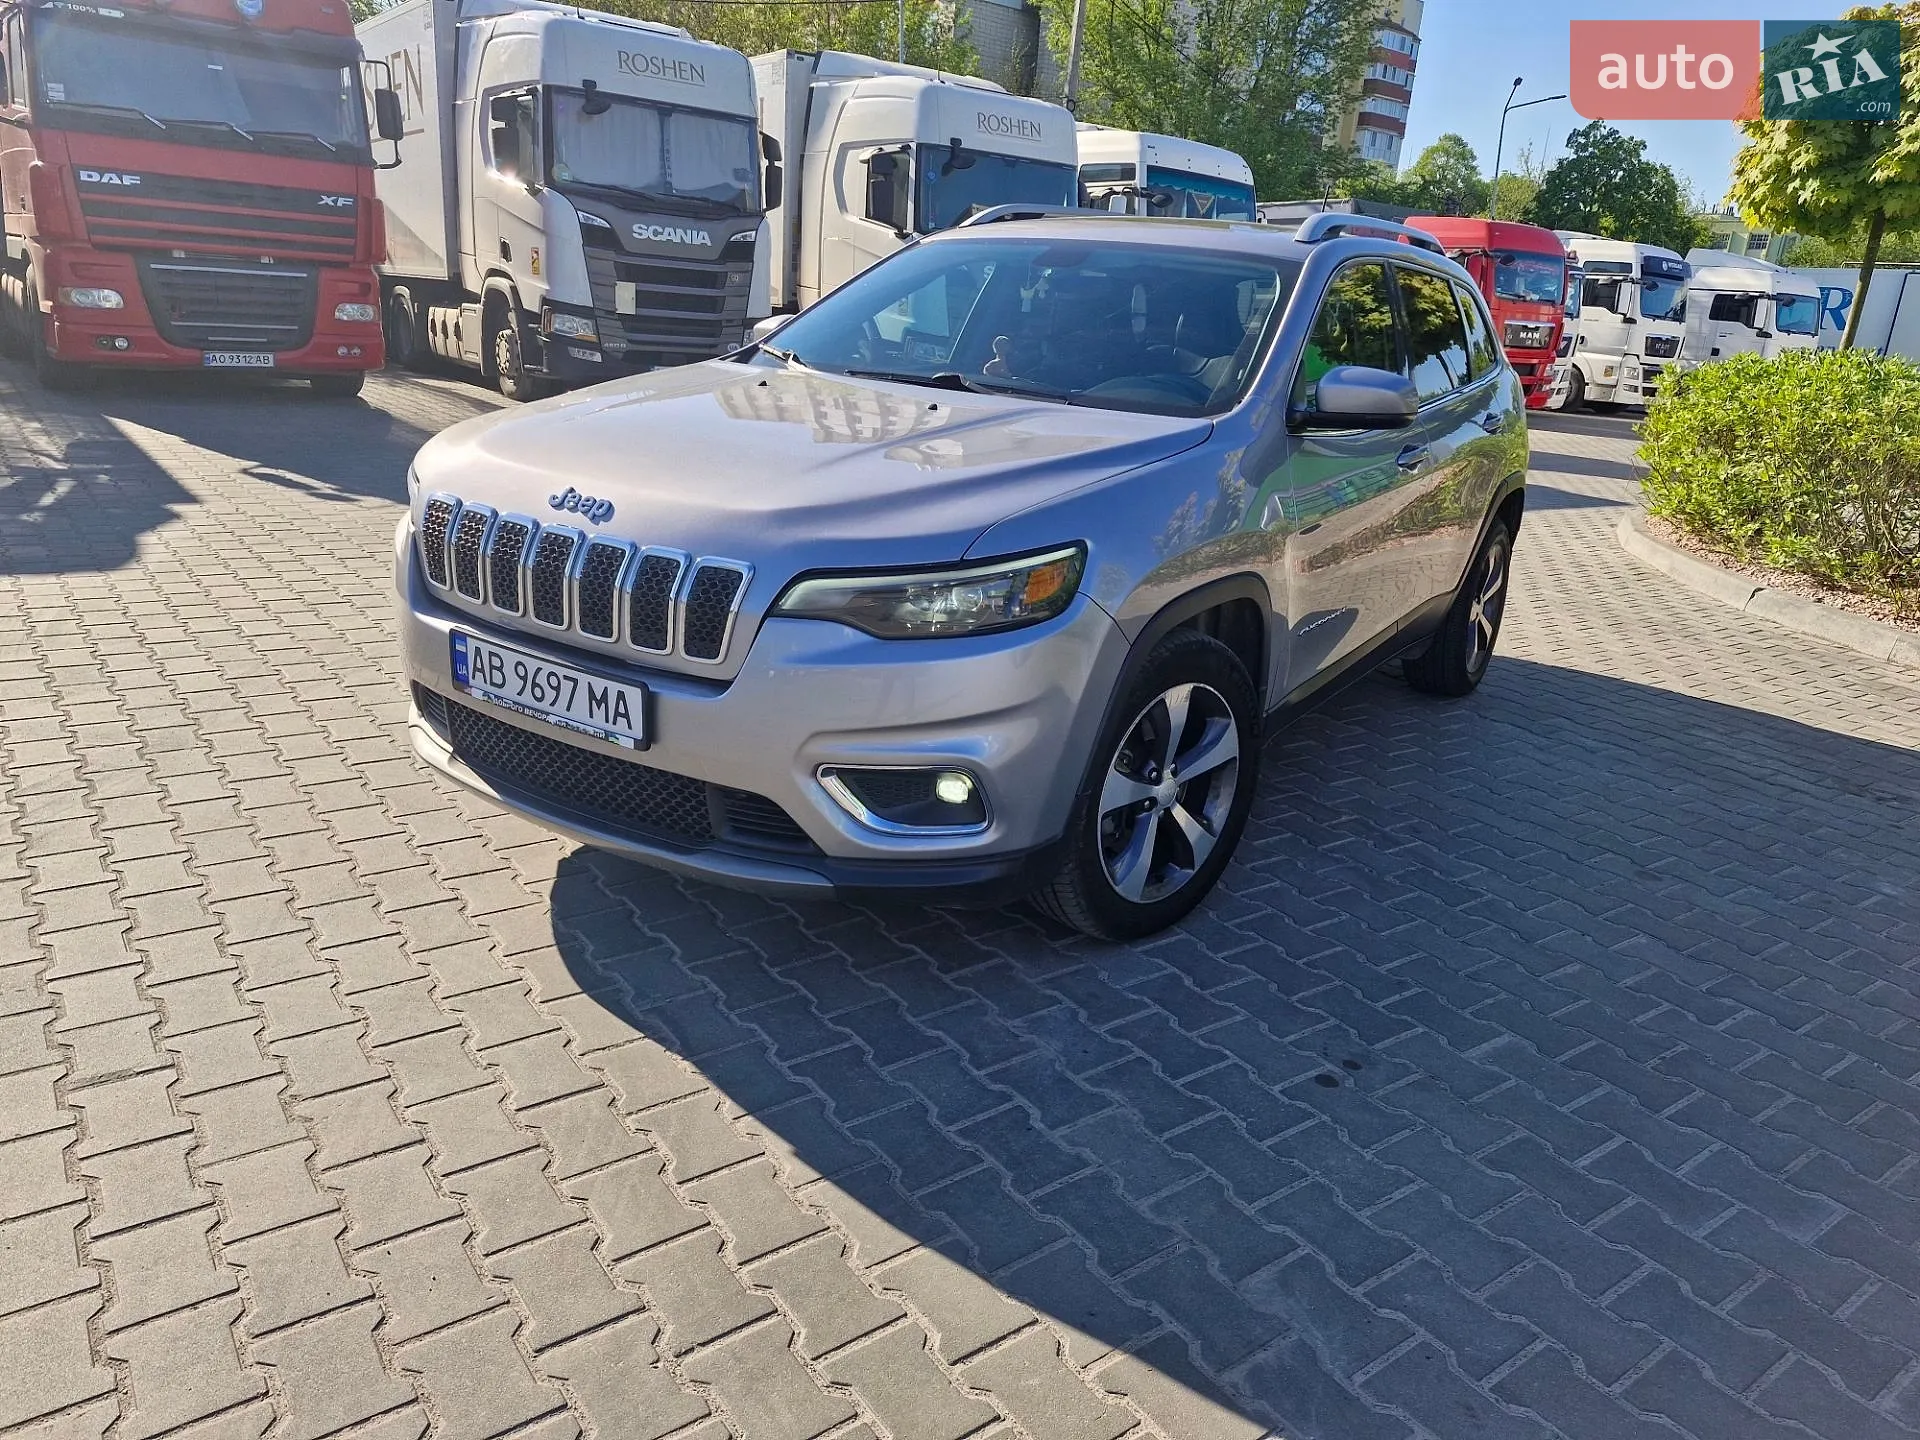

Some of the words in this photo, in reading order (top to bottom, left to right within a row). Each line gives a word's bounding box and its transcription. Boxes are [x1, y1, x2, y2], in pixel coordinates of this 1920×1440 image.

[67, 3, 96, 14] 100%
[617, 50, 706, 82] ROSHEN
[977, 112, 1041, 138] ROSHEN
[79, 170, 141, 185] DAF
[317, 195, 354, 207] XF
[632, 223, 712, 247] SCANIA
[1519, 331, 1541, 340] MAN
[211, 354, 226, 364] AO
[228, 354, 253, 364] 9312
[255, 355, 270, 365] AB
[548, 487, 615, 526] Jeep
[456, 664, 468, 676] UA
[471, 646, 507, 690] AB
[514, 660, 579, 713] 9697
[587, 681, 633, 731] MA
